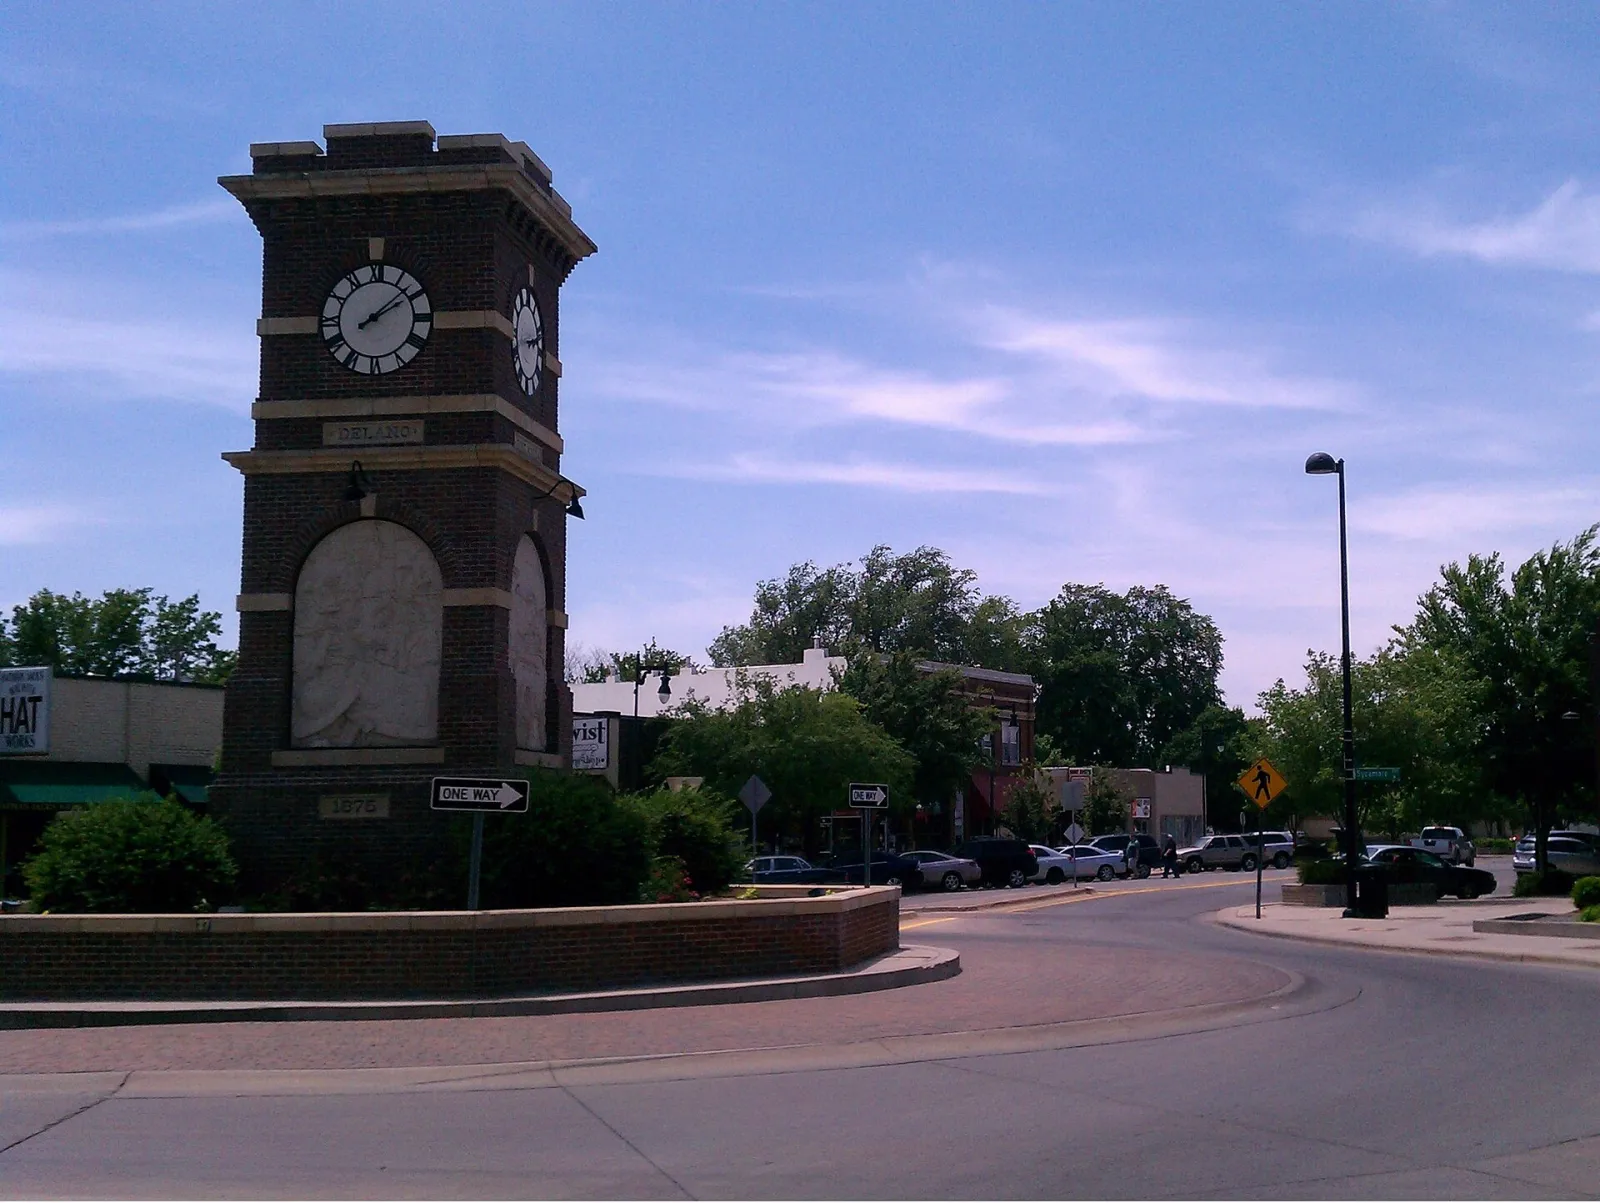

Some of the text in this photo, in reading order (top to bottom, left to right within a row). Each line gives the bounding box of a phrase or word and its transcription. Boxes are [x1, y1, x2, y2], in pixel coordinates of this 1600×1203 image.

[338, 426, 410, 440] DELANO
[1, 696, 43, 734] HAT
[443, 788, 500, 801] ONE WAY
[854, 791, 876, 800] ONE WAY
